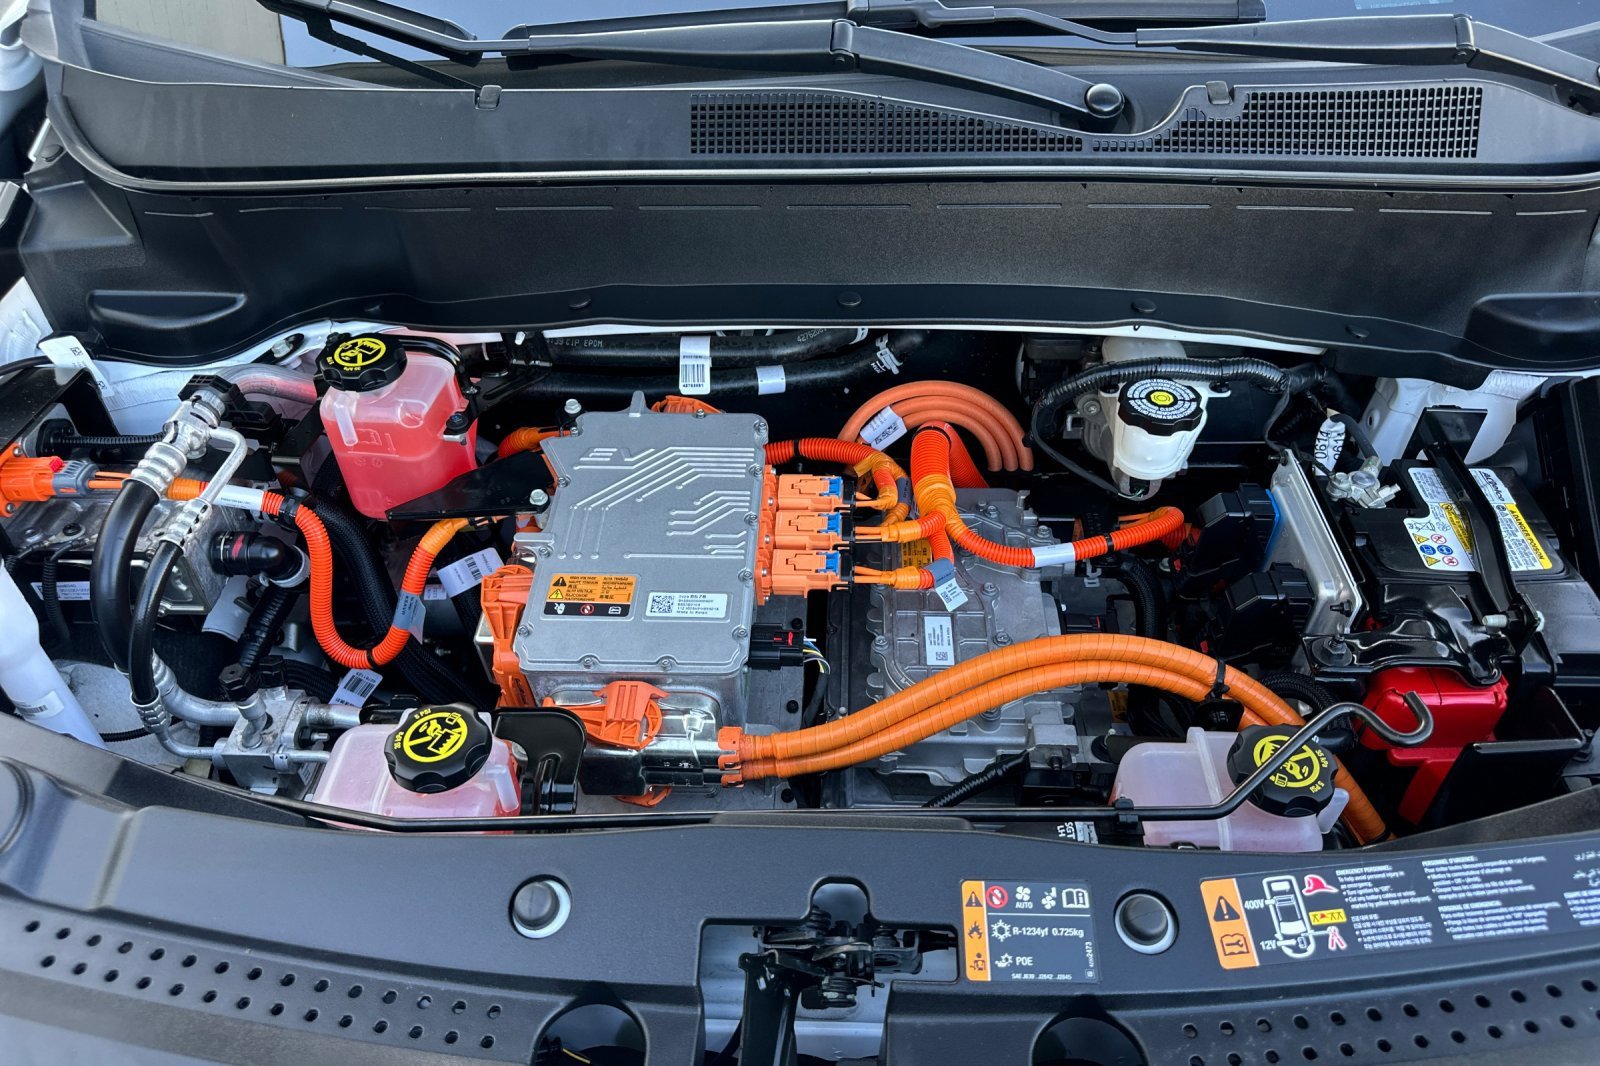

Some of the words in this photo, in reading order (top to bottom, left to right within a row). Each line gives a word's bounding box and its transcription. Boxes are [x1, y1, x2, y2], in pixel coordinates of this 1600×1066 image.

[420, 708, 432, 717] PSI
[1309, 784, 1321, 793] PSI
[1057, 825, 1066, 837] LH
[1065, 822, 1076, 840] SGT
[1244, 899, 1265, 909] 400V
[1012, 927, 1049, 938] R-1234yf
[1052, 928, 1084, 938] 0.725kg
[1260, 940, 1276, 950] 12V
[1016, 957, 1033, 966] POE
